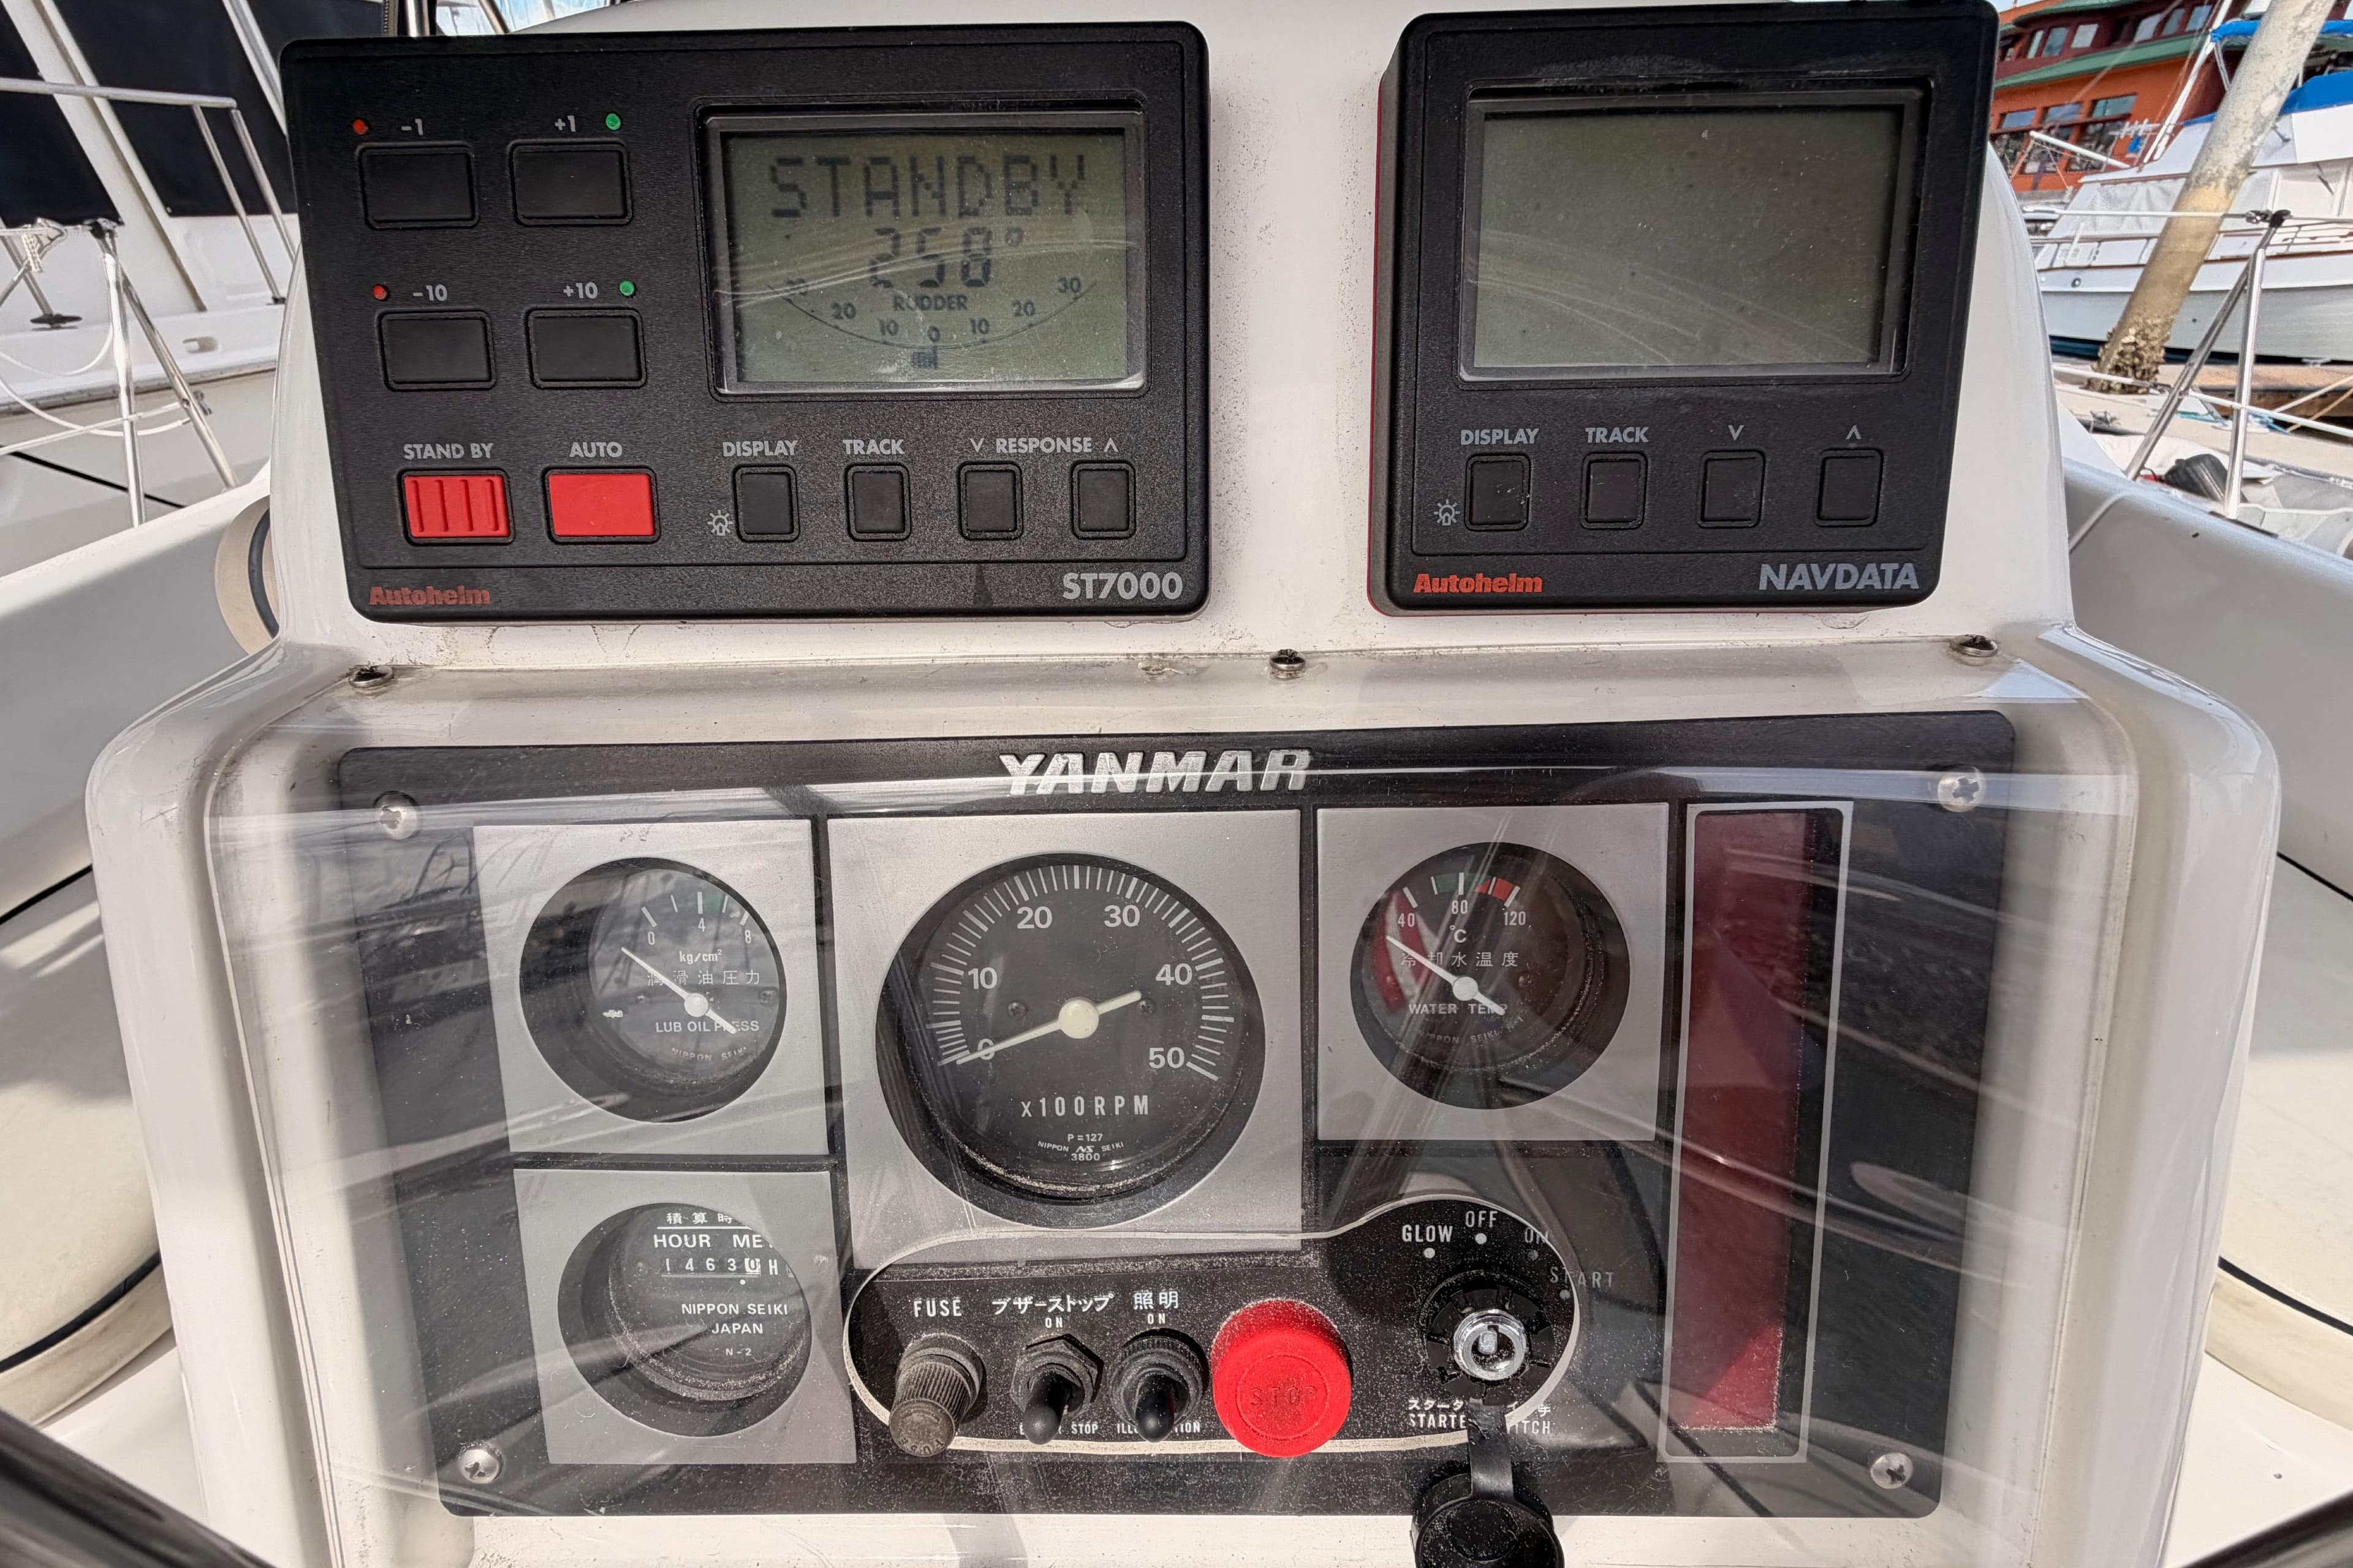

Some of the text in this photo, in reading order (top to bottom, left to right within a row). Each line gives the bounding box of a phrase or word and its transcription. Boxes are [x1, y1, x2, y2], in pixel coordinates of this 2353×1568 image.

[770, 155, 1085, 218] STANDBY
[412, 284, 447, 301] -10
[563, 282, 598, 299] +10
[1057, 277, 1082, 294] 30
[831, 302, 857, 320] 20
[1013, 301, 1036, 317] 20
[878, 319, 899, 336] 10
[927, 325, 941, 343] 0
[969, 317, 990, 335] 10
[1460, 427, 1540, 447] DISPLAY
[1585, 426, 1649, 444] TRACK
[403, 442, 494, 460] STAND BY
[569, 441, 623, 458] AUTO
[722, 439, 798, 457] DISPLAY
[843, 439, 905, 456] TRACK
[995, 437, 1092, 454] RESPONSE
[1412, 572, 1543, 594] Autohelm
[1758, 562, 1920, 591] NAVDATA
[1063, 572, 1183, 600] ST7000
[369, 585, 491, 605] Autohelm
[999, 749, 1311, 795] YANMAR
[1103, 904, 1141, 928] 30
[1451, 900, 1469, 915] 80
[698, 918, 706, 932] 4
[1017, 906, 1053, 930] 20
[1397, 912, 1416, 928] 40
[1502, 911, 1527, 926] 120
[647, 931, 656, 945] 0
[744, 930, 752, 944] 8
[968, 966, 998, 990] 10
[1155, 963, 1193, 986] 40
[1409, 1003, 1458, 1015] WATER
[656, 1021, 682, 1033] LUB
[687, 1021, 711, 1032] OIL
[977, 1038, 996, 1061] 0
[1148, 1047, 1185, 1069] 50
[1037, 1140, 1069, 1152] NIPPON
[1101, 1141, 1124, 1152] SEIKI
[1070, 1153, 1101, 1162] 3800
[1465, 1210, 1498, 1228] OFF
[653, 1234, 711, 1248] HOUR
[1401, 1224, 1453, 1243] GLOW
[913, 1298, 963, 1317] FUSE
[991, 1293, 1114, 1315] ブザーストップ
[1133, 1291, 1180, 1310] 照明
[681, 1303, 789, 1316] NIPPON SEIKI
[1045, 1317, 1063, 1328] ON
[1147, 1313, 1165, 1325] ON
[711, 1323, 763, 1335] JAPAN
[1071, 1423, 1099, 1434] STOP
